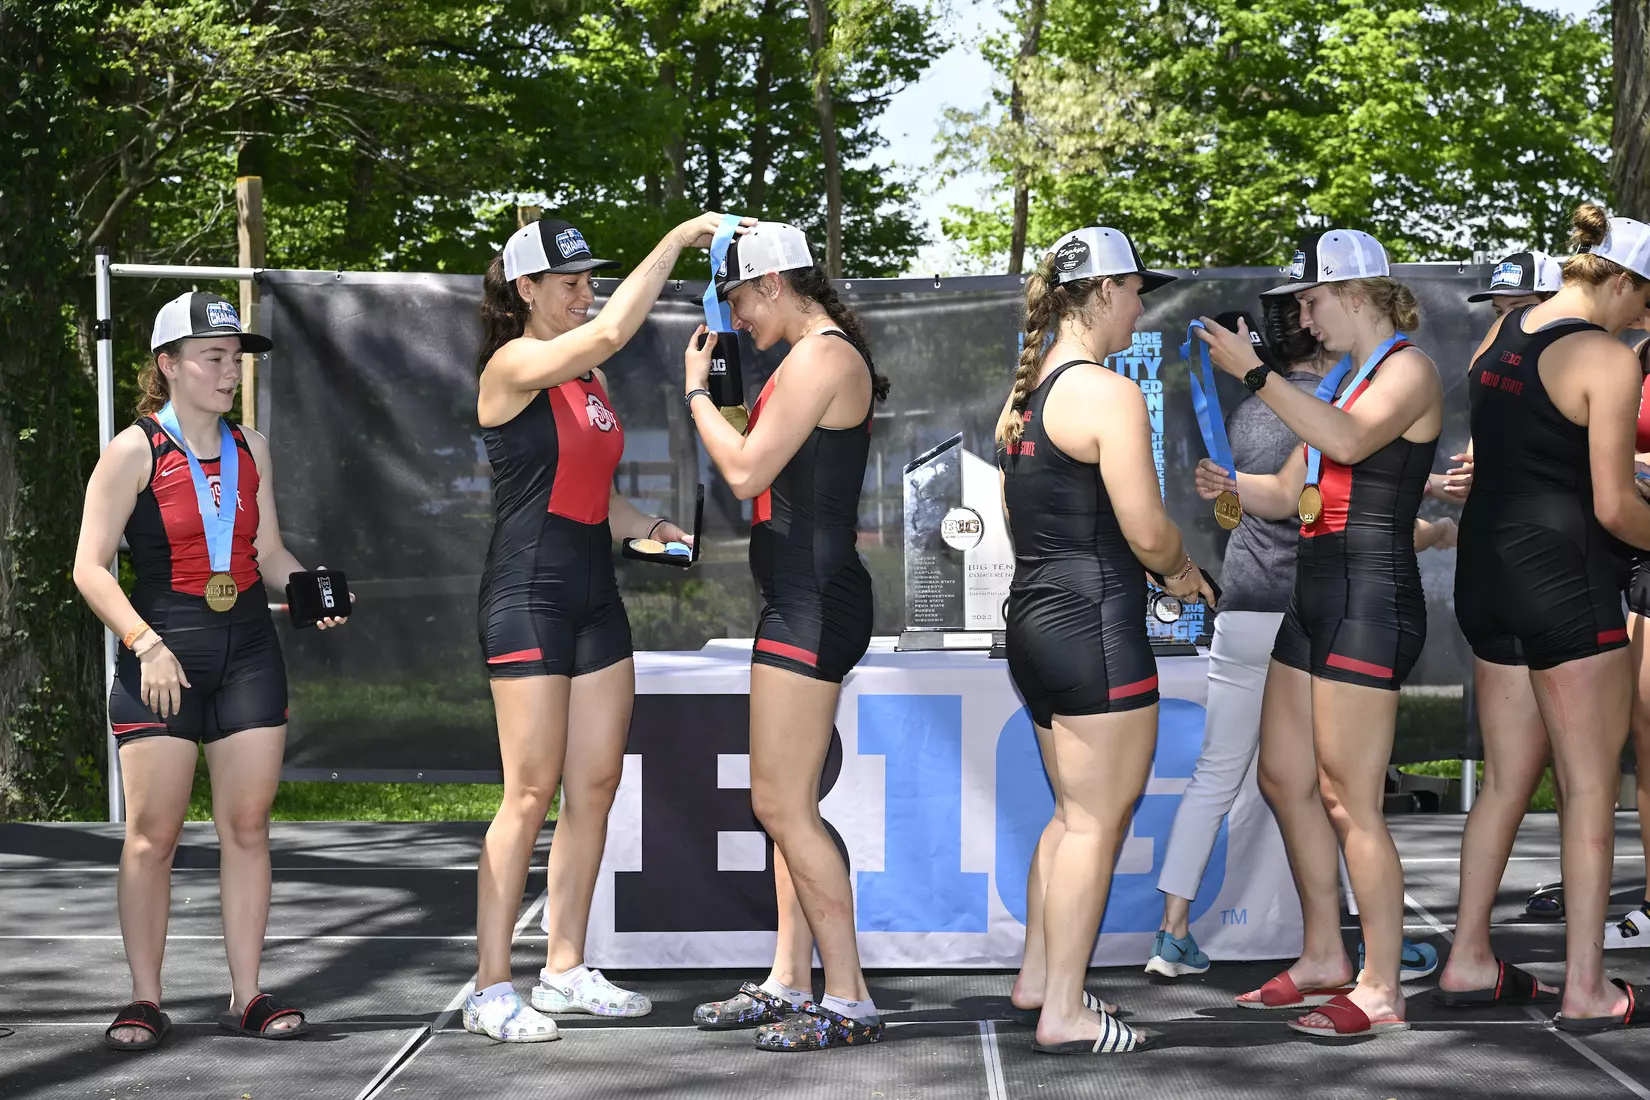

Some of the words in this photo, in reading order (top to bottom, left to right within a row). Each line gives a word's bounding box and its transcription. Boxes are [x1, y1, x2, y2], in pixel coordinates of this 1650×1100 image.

[1481, 370, 1500, 388] OHIO
[1501, 377, 1524, 395] STATE
[992, 563, 1014, 571] TEN
[1221, 908, 1247, 925] TM
